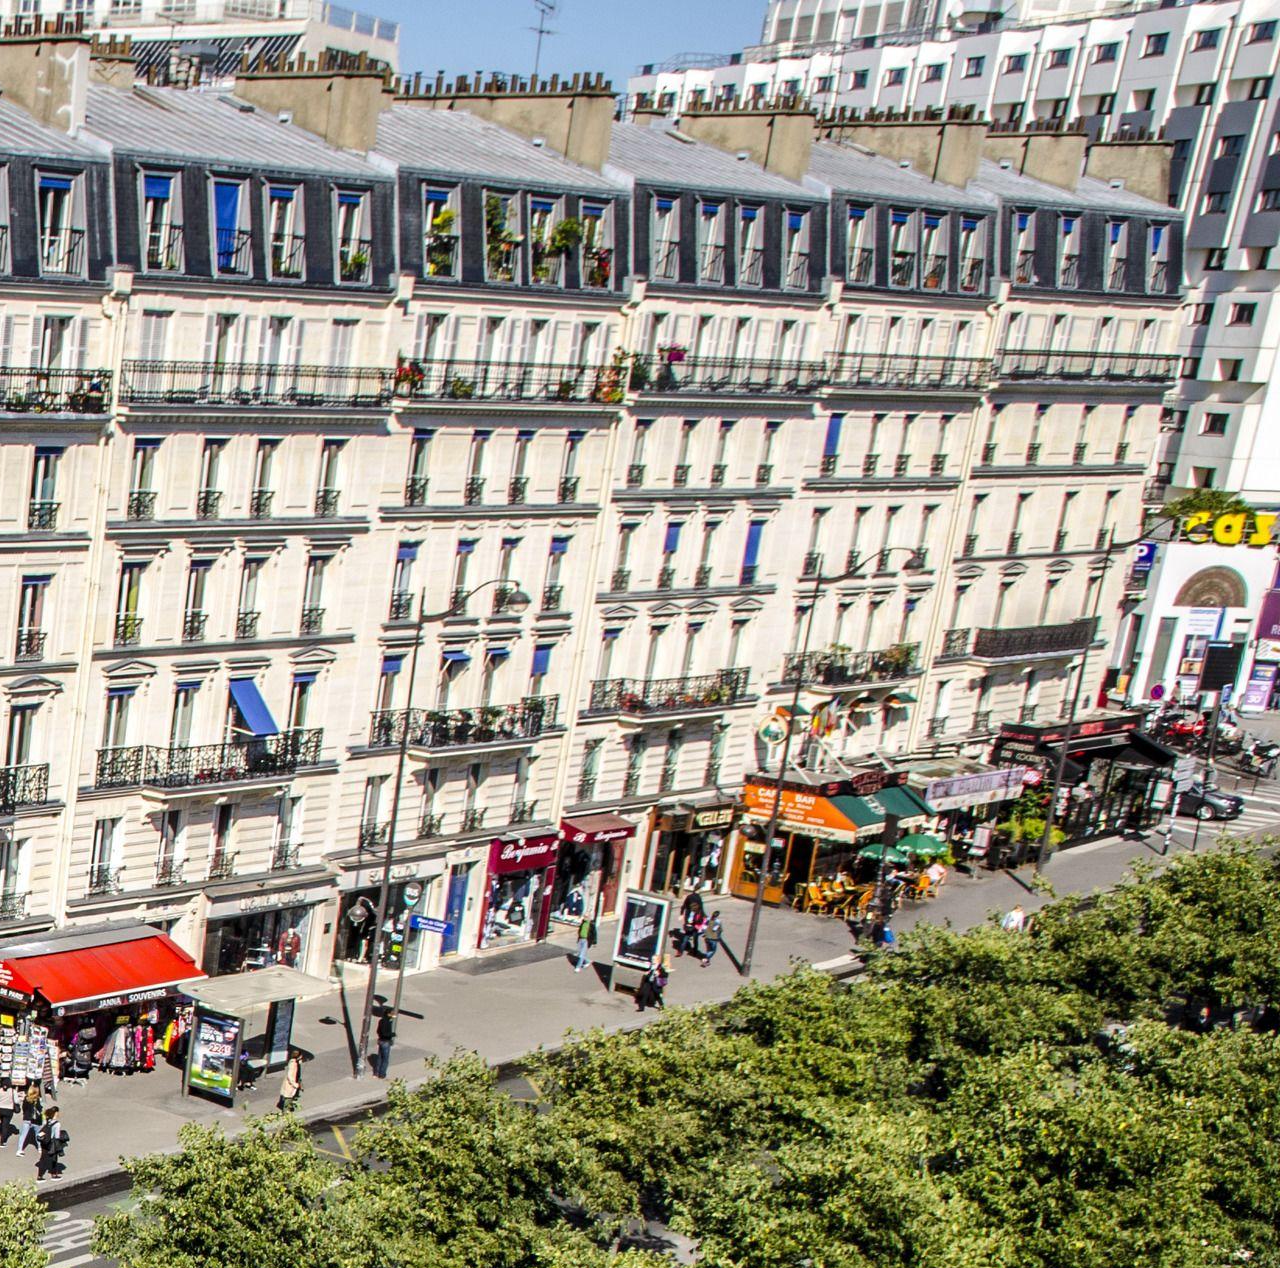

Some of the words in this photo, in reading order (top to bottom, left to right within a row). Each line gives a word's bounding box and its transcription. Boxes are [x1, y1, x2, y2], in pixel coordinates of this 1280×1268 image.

[1134, 545, 1148, 561] P
[758, 787, 783, 800] CAF
[501, 843, 549, 862] Benjamin
[129, 988, 166, 1002] SOUVENIRS
